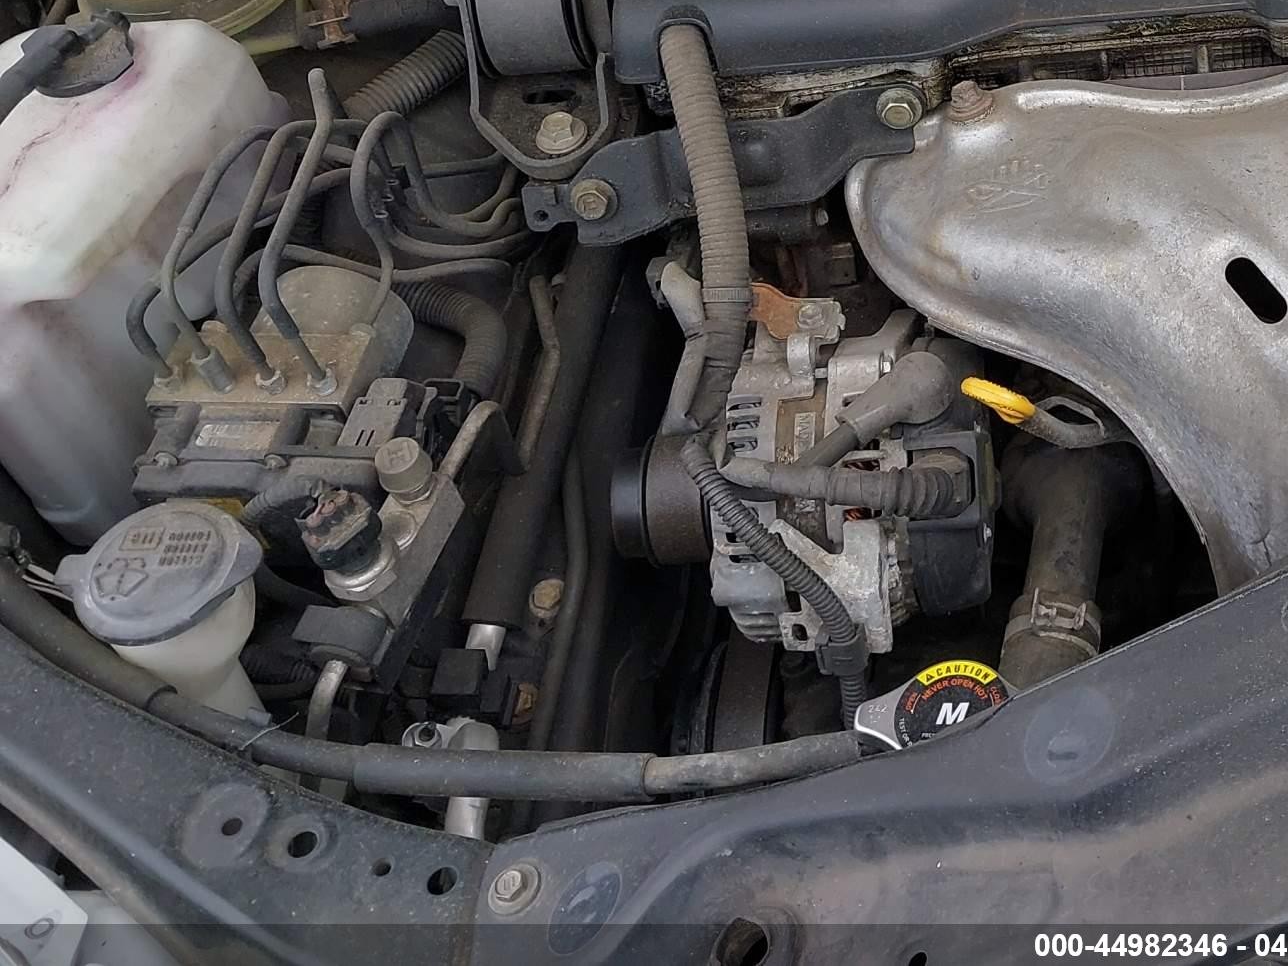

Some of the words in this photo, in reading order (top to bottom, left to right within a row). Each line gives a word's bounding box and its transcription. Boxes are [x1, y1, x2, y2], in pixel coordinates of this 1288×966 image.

[936, 664, 990, 682] CAUTION
[921, 680, 950, 701] NEVER
[950, 677, 974, 688] OPEN
[974, 684, 989, 700] HOT
